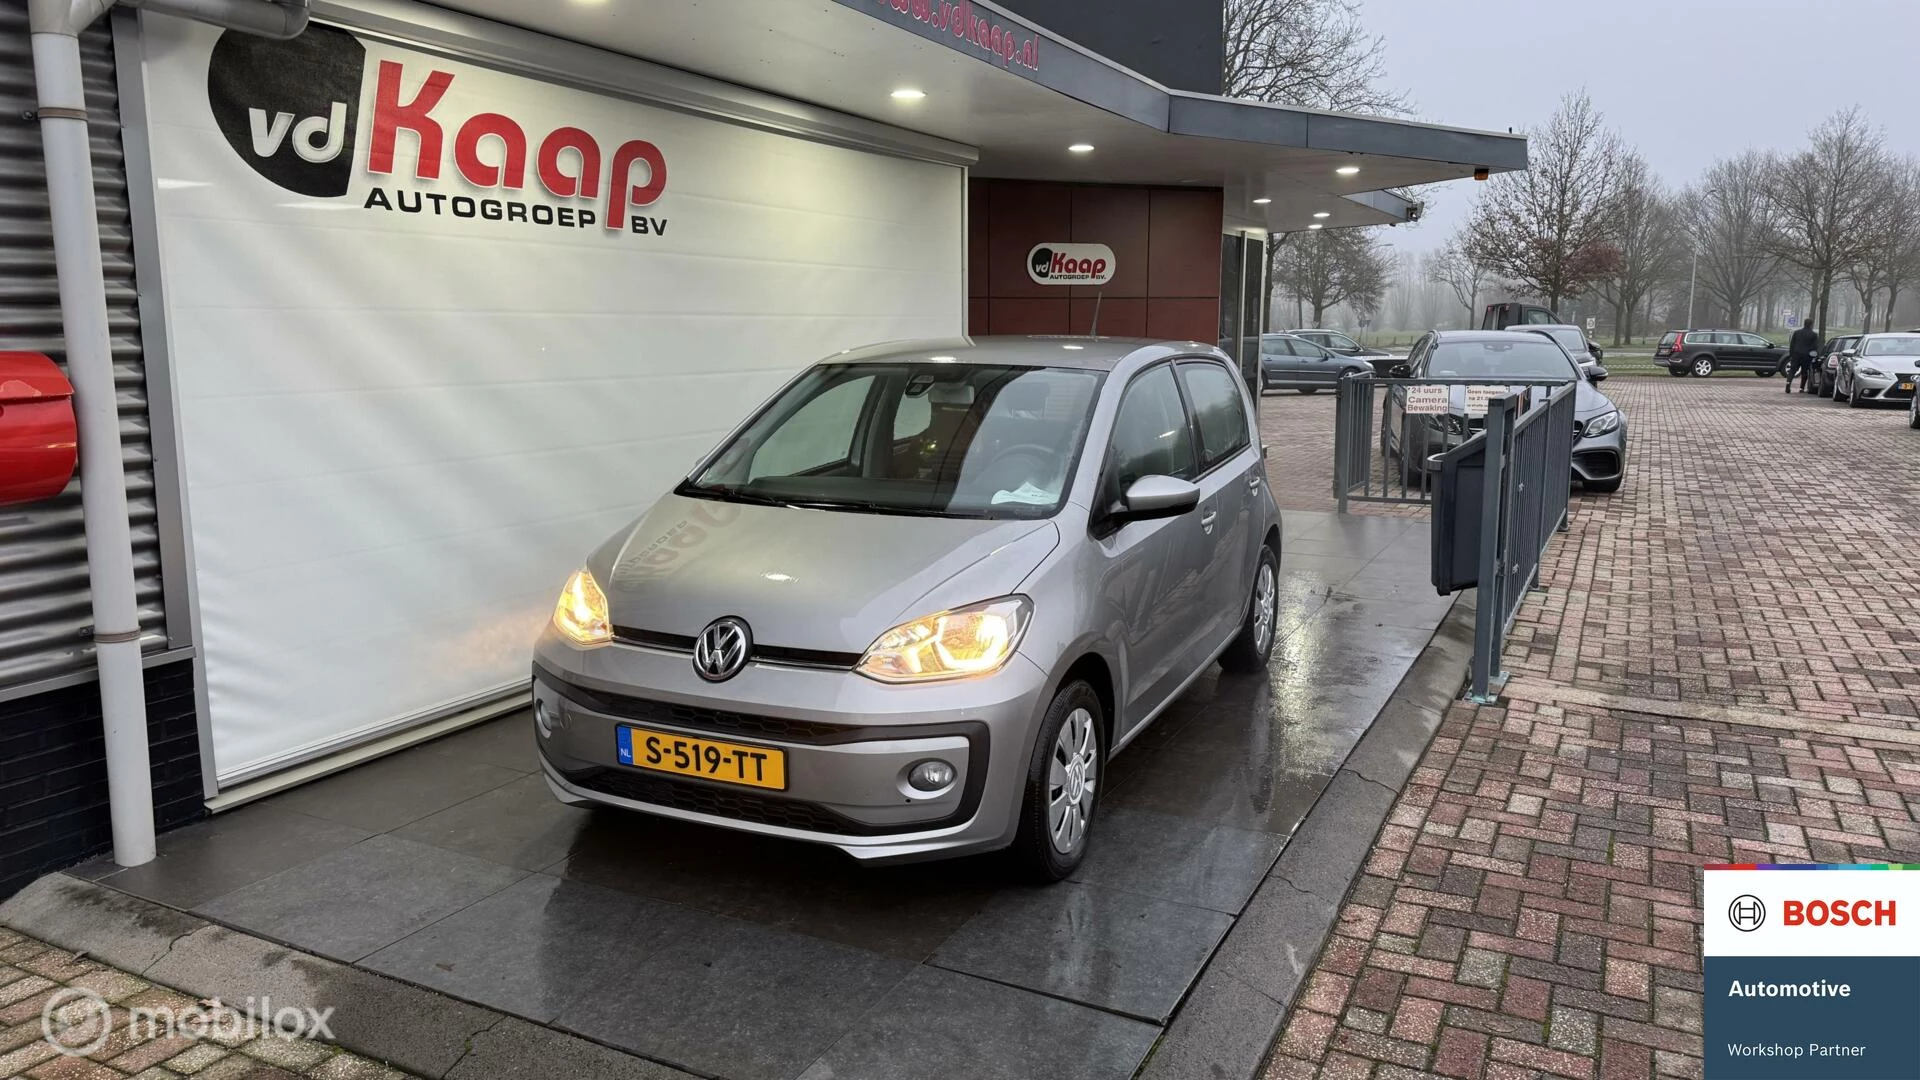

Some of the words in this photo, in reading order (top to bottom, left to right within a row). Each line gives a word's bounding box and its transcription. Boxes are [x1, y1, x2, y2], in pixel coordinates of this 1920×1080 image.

[876, 0, 1039, 70] w.vdkaap.nl
[248, 101, 347, 163] vd
[368, 59, 667, 230] Kaap
[364, 187, 596, 228] AUTOGROEP
[631, 215, 668, 236] BV
[1051, 253, 1107, 279] Kaap
[1408, 396, 1448, 404] Camera
[620, 748, 632, 758] NL
[646, 737, 767, 781] S-519-TT
